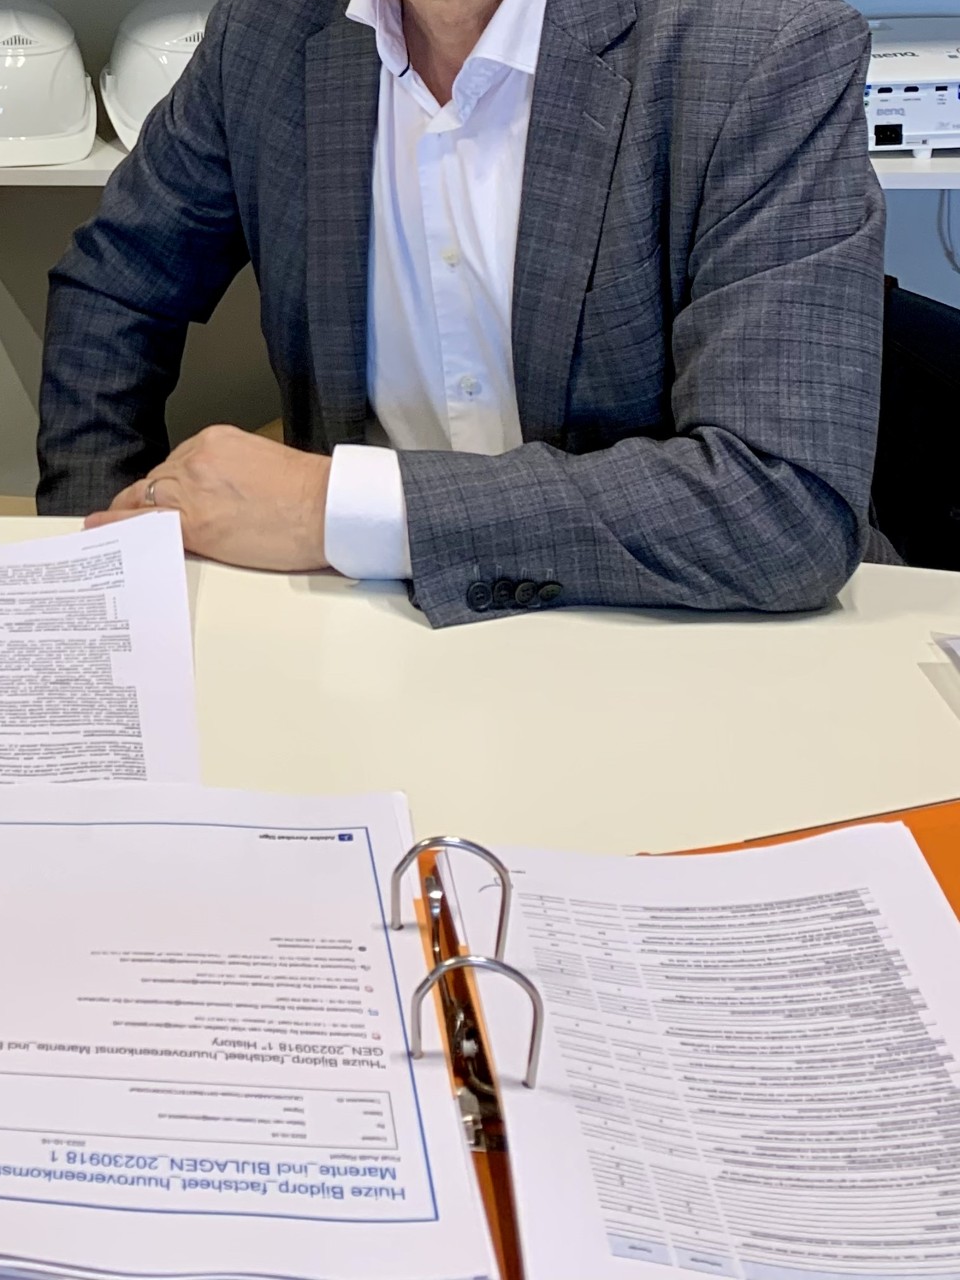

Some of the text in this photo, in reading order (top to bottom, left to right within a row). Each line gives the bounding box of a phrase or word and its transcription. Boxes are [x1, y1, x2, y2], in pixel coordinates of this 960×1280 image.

[8, 1041, 90, 1055] Marente_incl
[211, 1038, 257, 1050] History
[49, 1150, 396, 1180] Marente_incl BIJLAGEN_20230918 1
[350, 1186, 406, 1200] Huize
